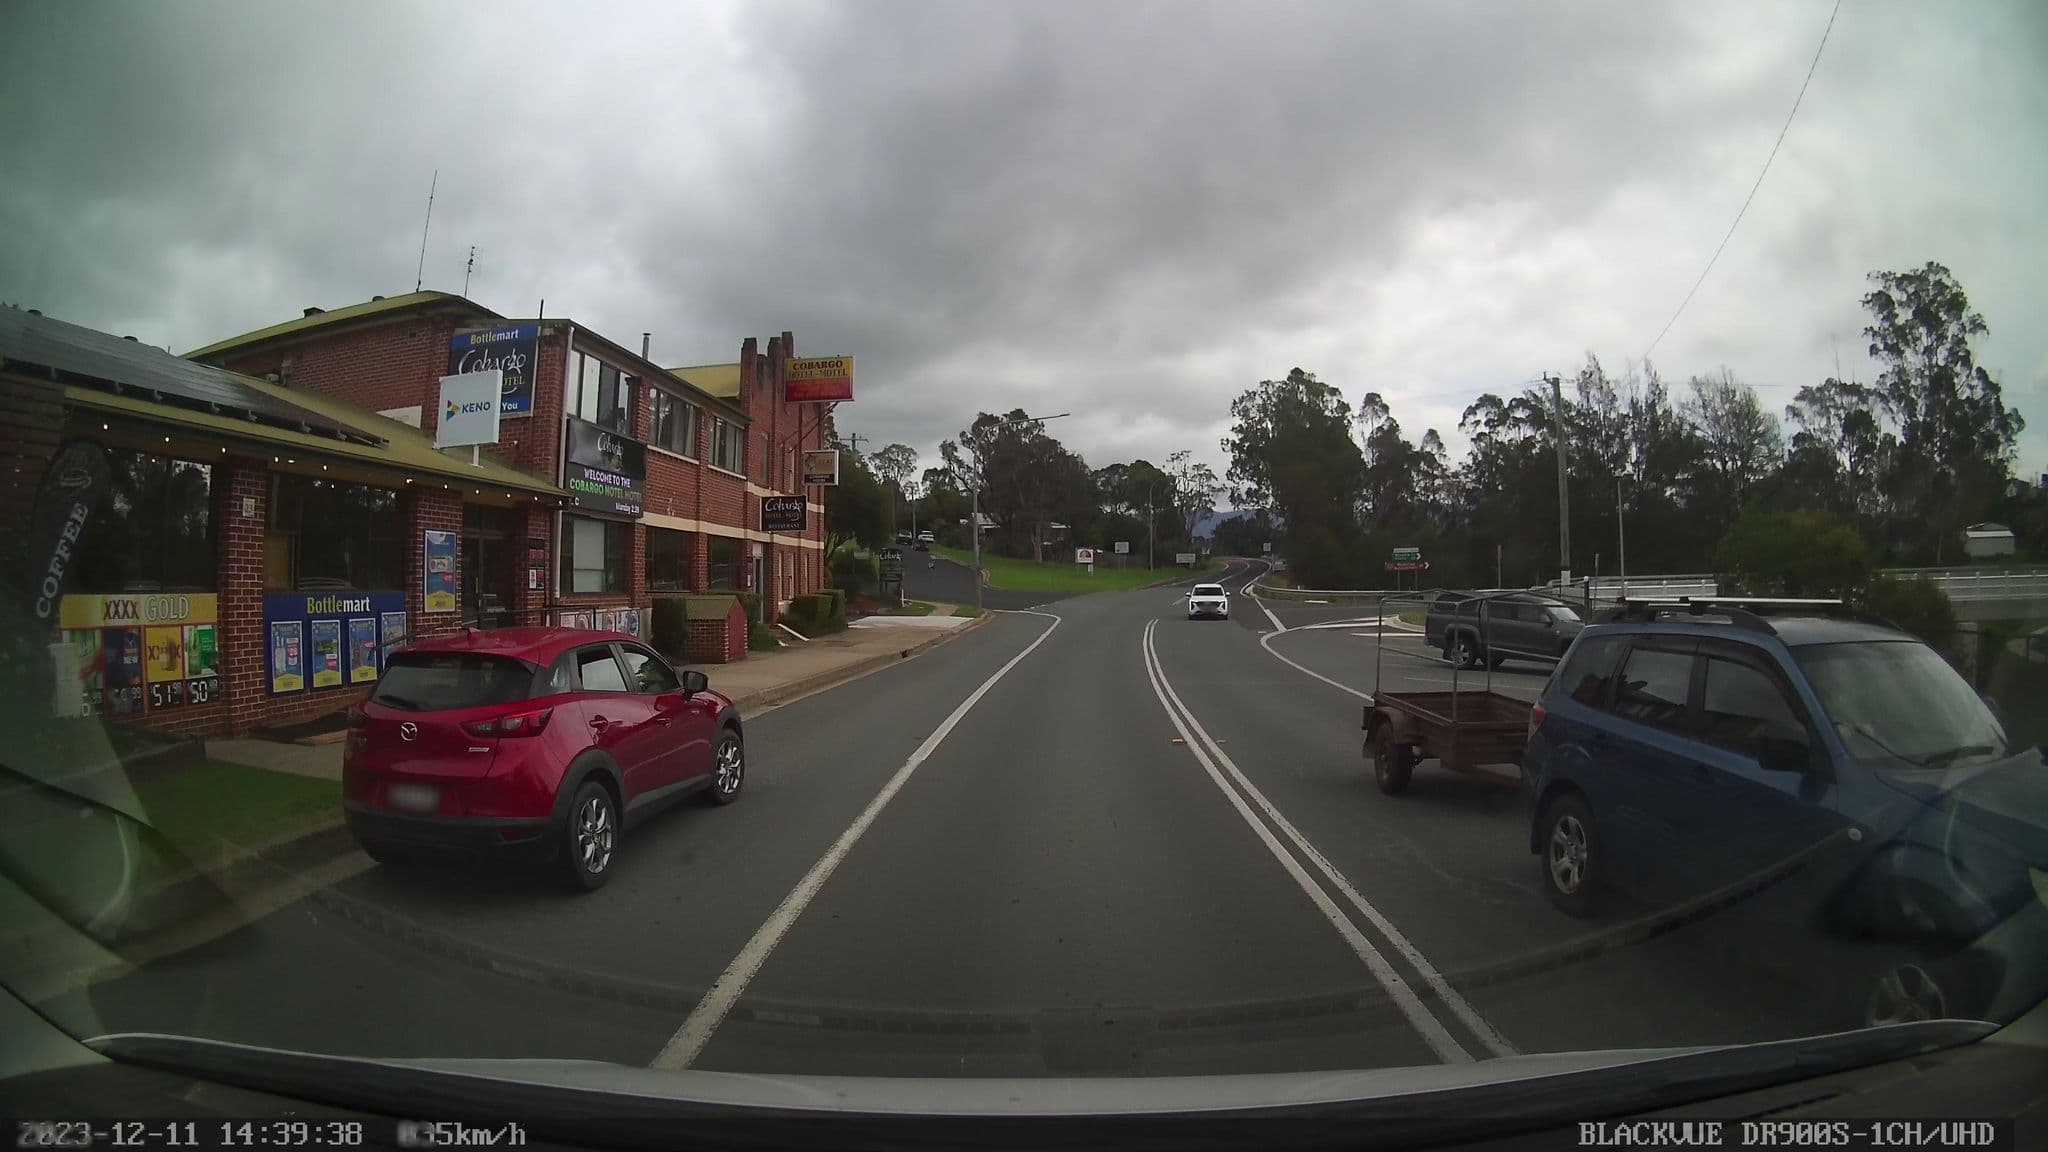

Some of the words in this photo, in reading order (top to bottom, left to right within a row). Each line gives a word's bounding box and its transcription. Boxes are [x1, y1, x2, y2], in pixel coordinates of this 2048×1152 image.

[470, 329, 518, 345] Bottlemart
[793, 360, 843, 371] COBARGO
[503, 375, 525, 386] OTEL
[462, 401, 491, 414] KENO
[584, 468, 612, 484] WELCOME
[613, 475, 621, 486] TO
[621, 477, 631, 488] THE
[36, 502, 89, 618] COFFEE
[103, 599, 140, 620] XXXX
[144, 596, 189, 621] GOLD
[307, 596, 371, 614] Bottlemart
